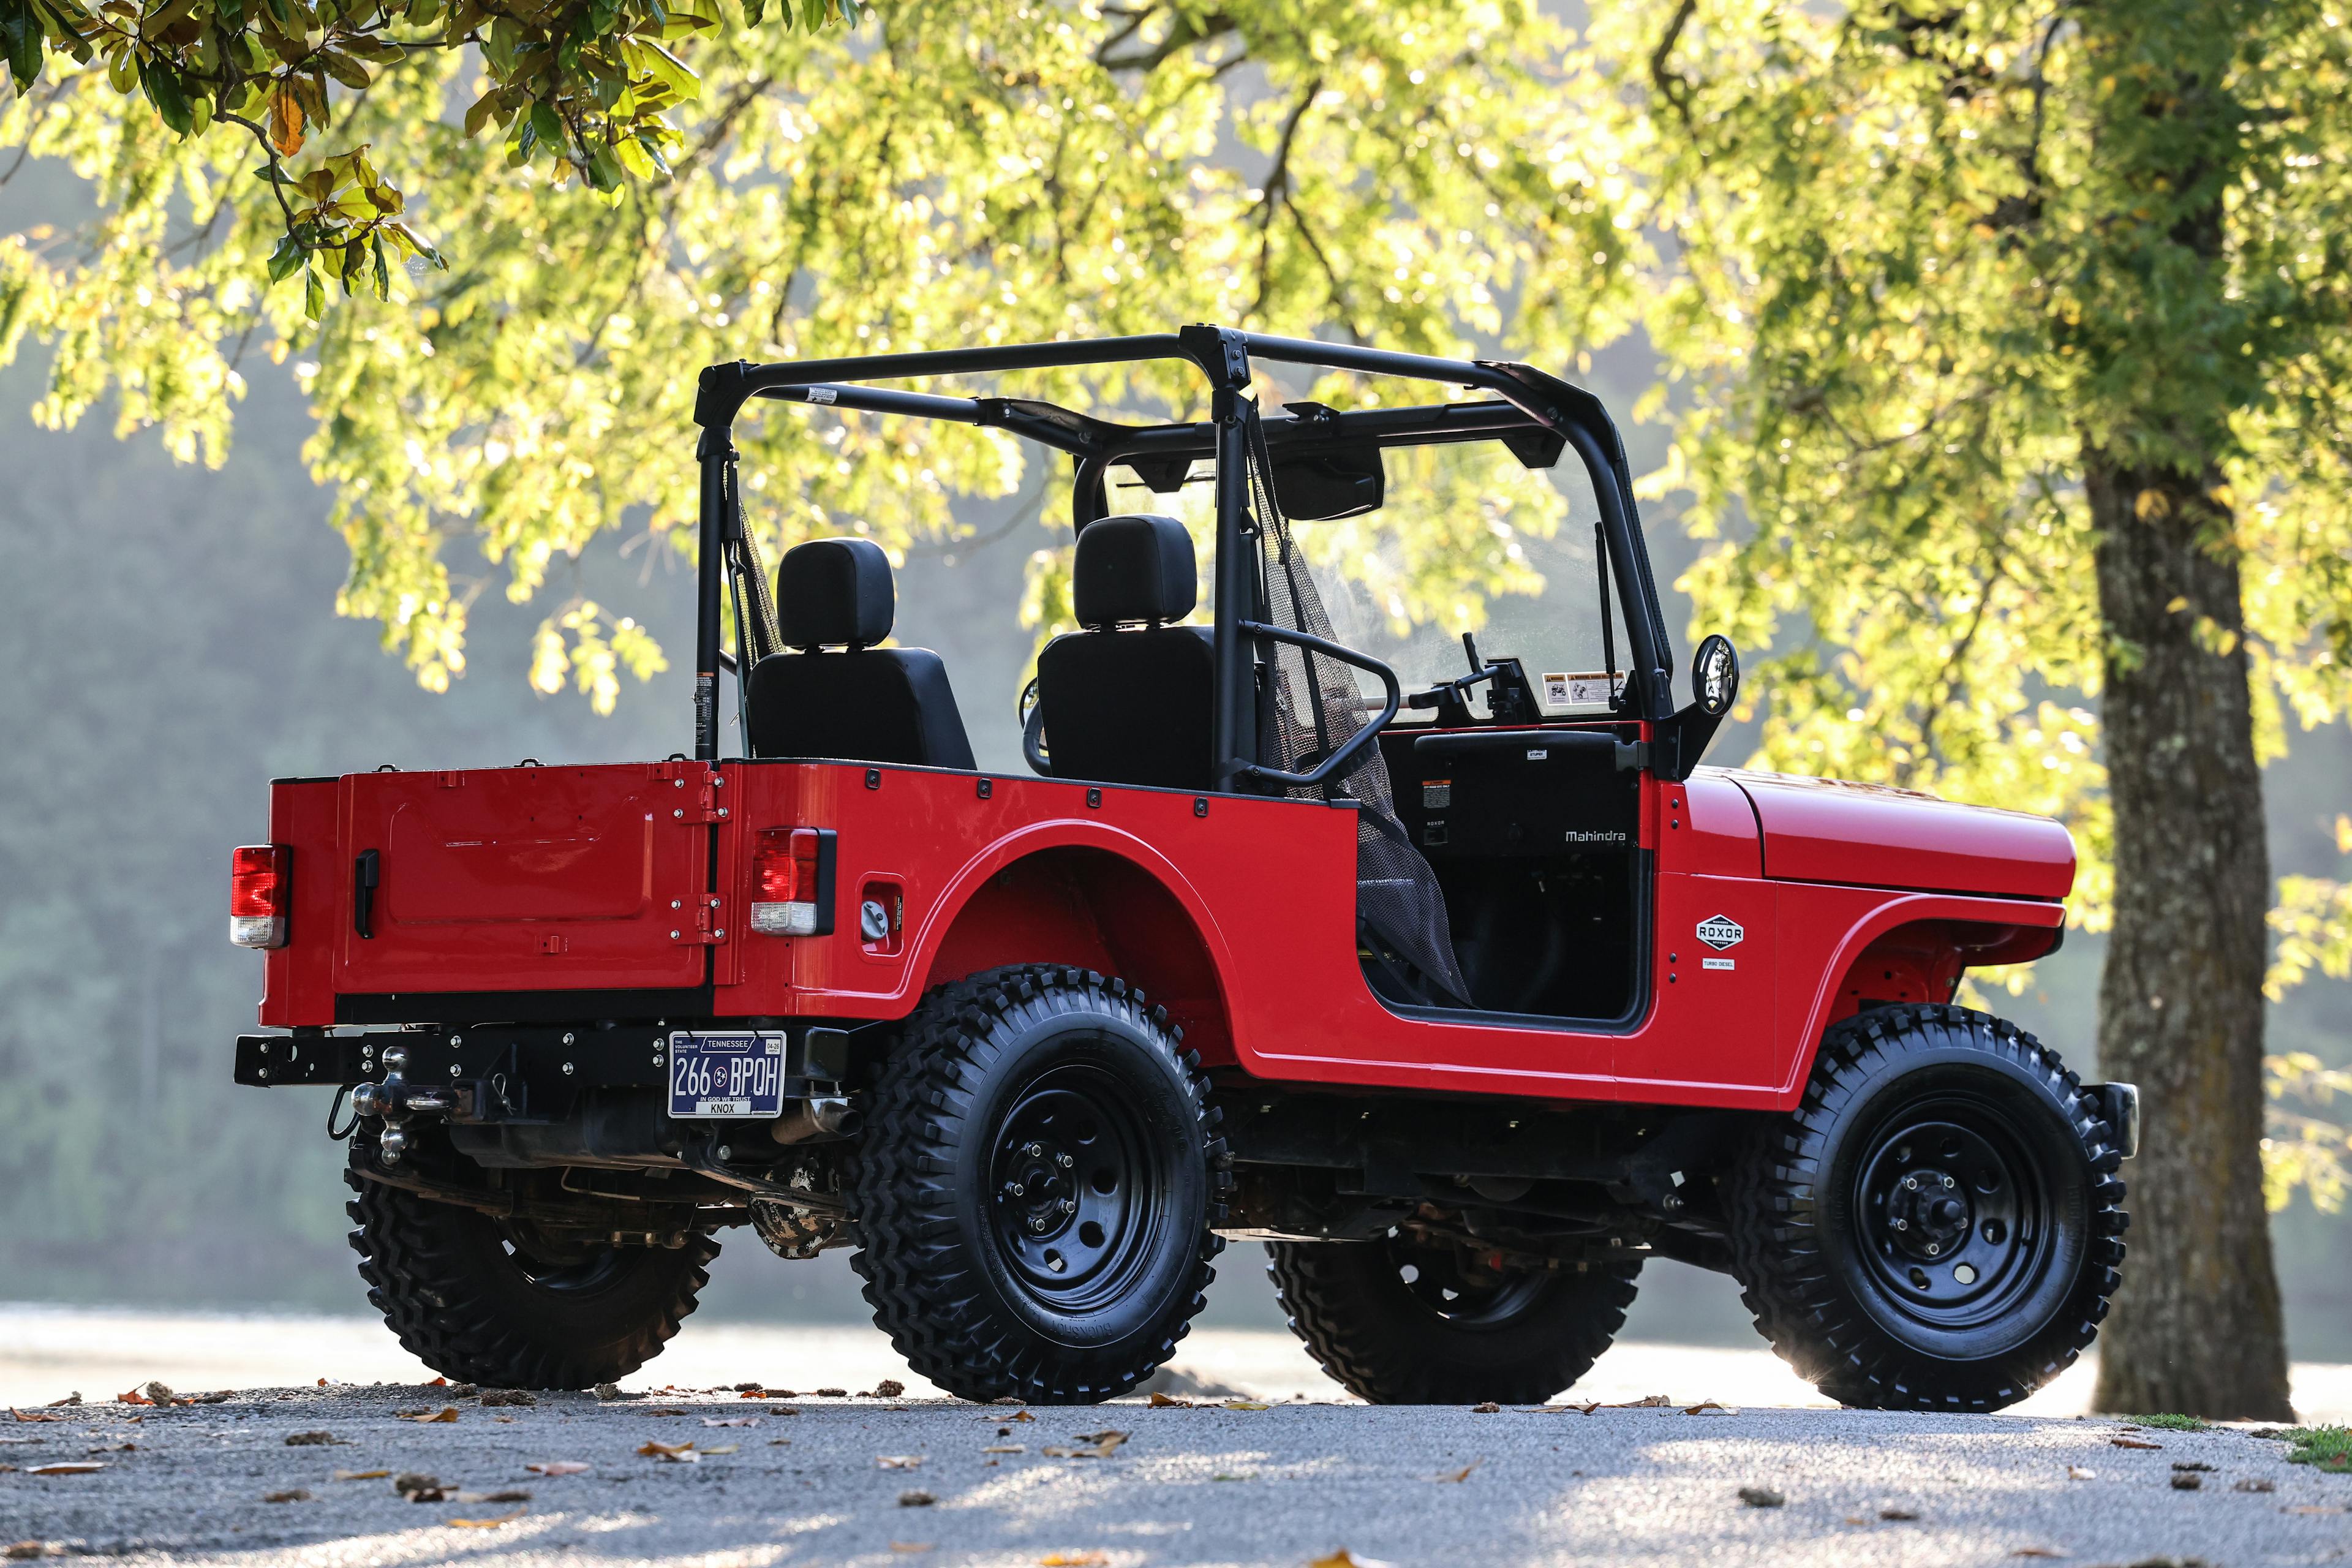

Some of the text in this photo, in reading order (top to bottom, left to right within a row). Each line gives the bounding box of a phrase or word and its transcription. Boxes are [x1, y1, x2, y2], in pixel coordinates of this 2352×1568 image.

[1566, 830, 1626, 842] Mahindra
[1700, 927, 1741, 939] ROXOR
[675, 1057, 710, 1096] 266
[729, 1057, 778, 1096] BPQH
[710, 1104, 734, 1114] KNOX
